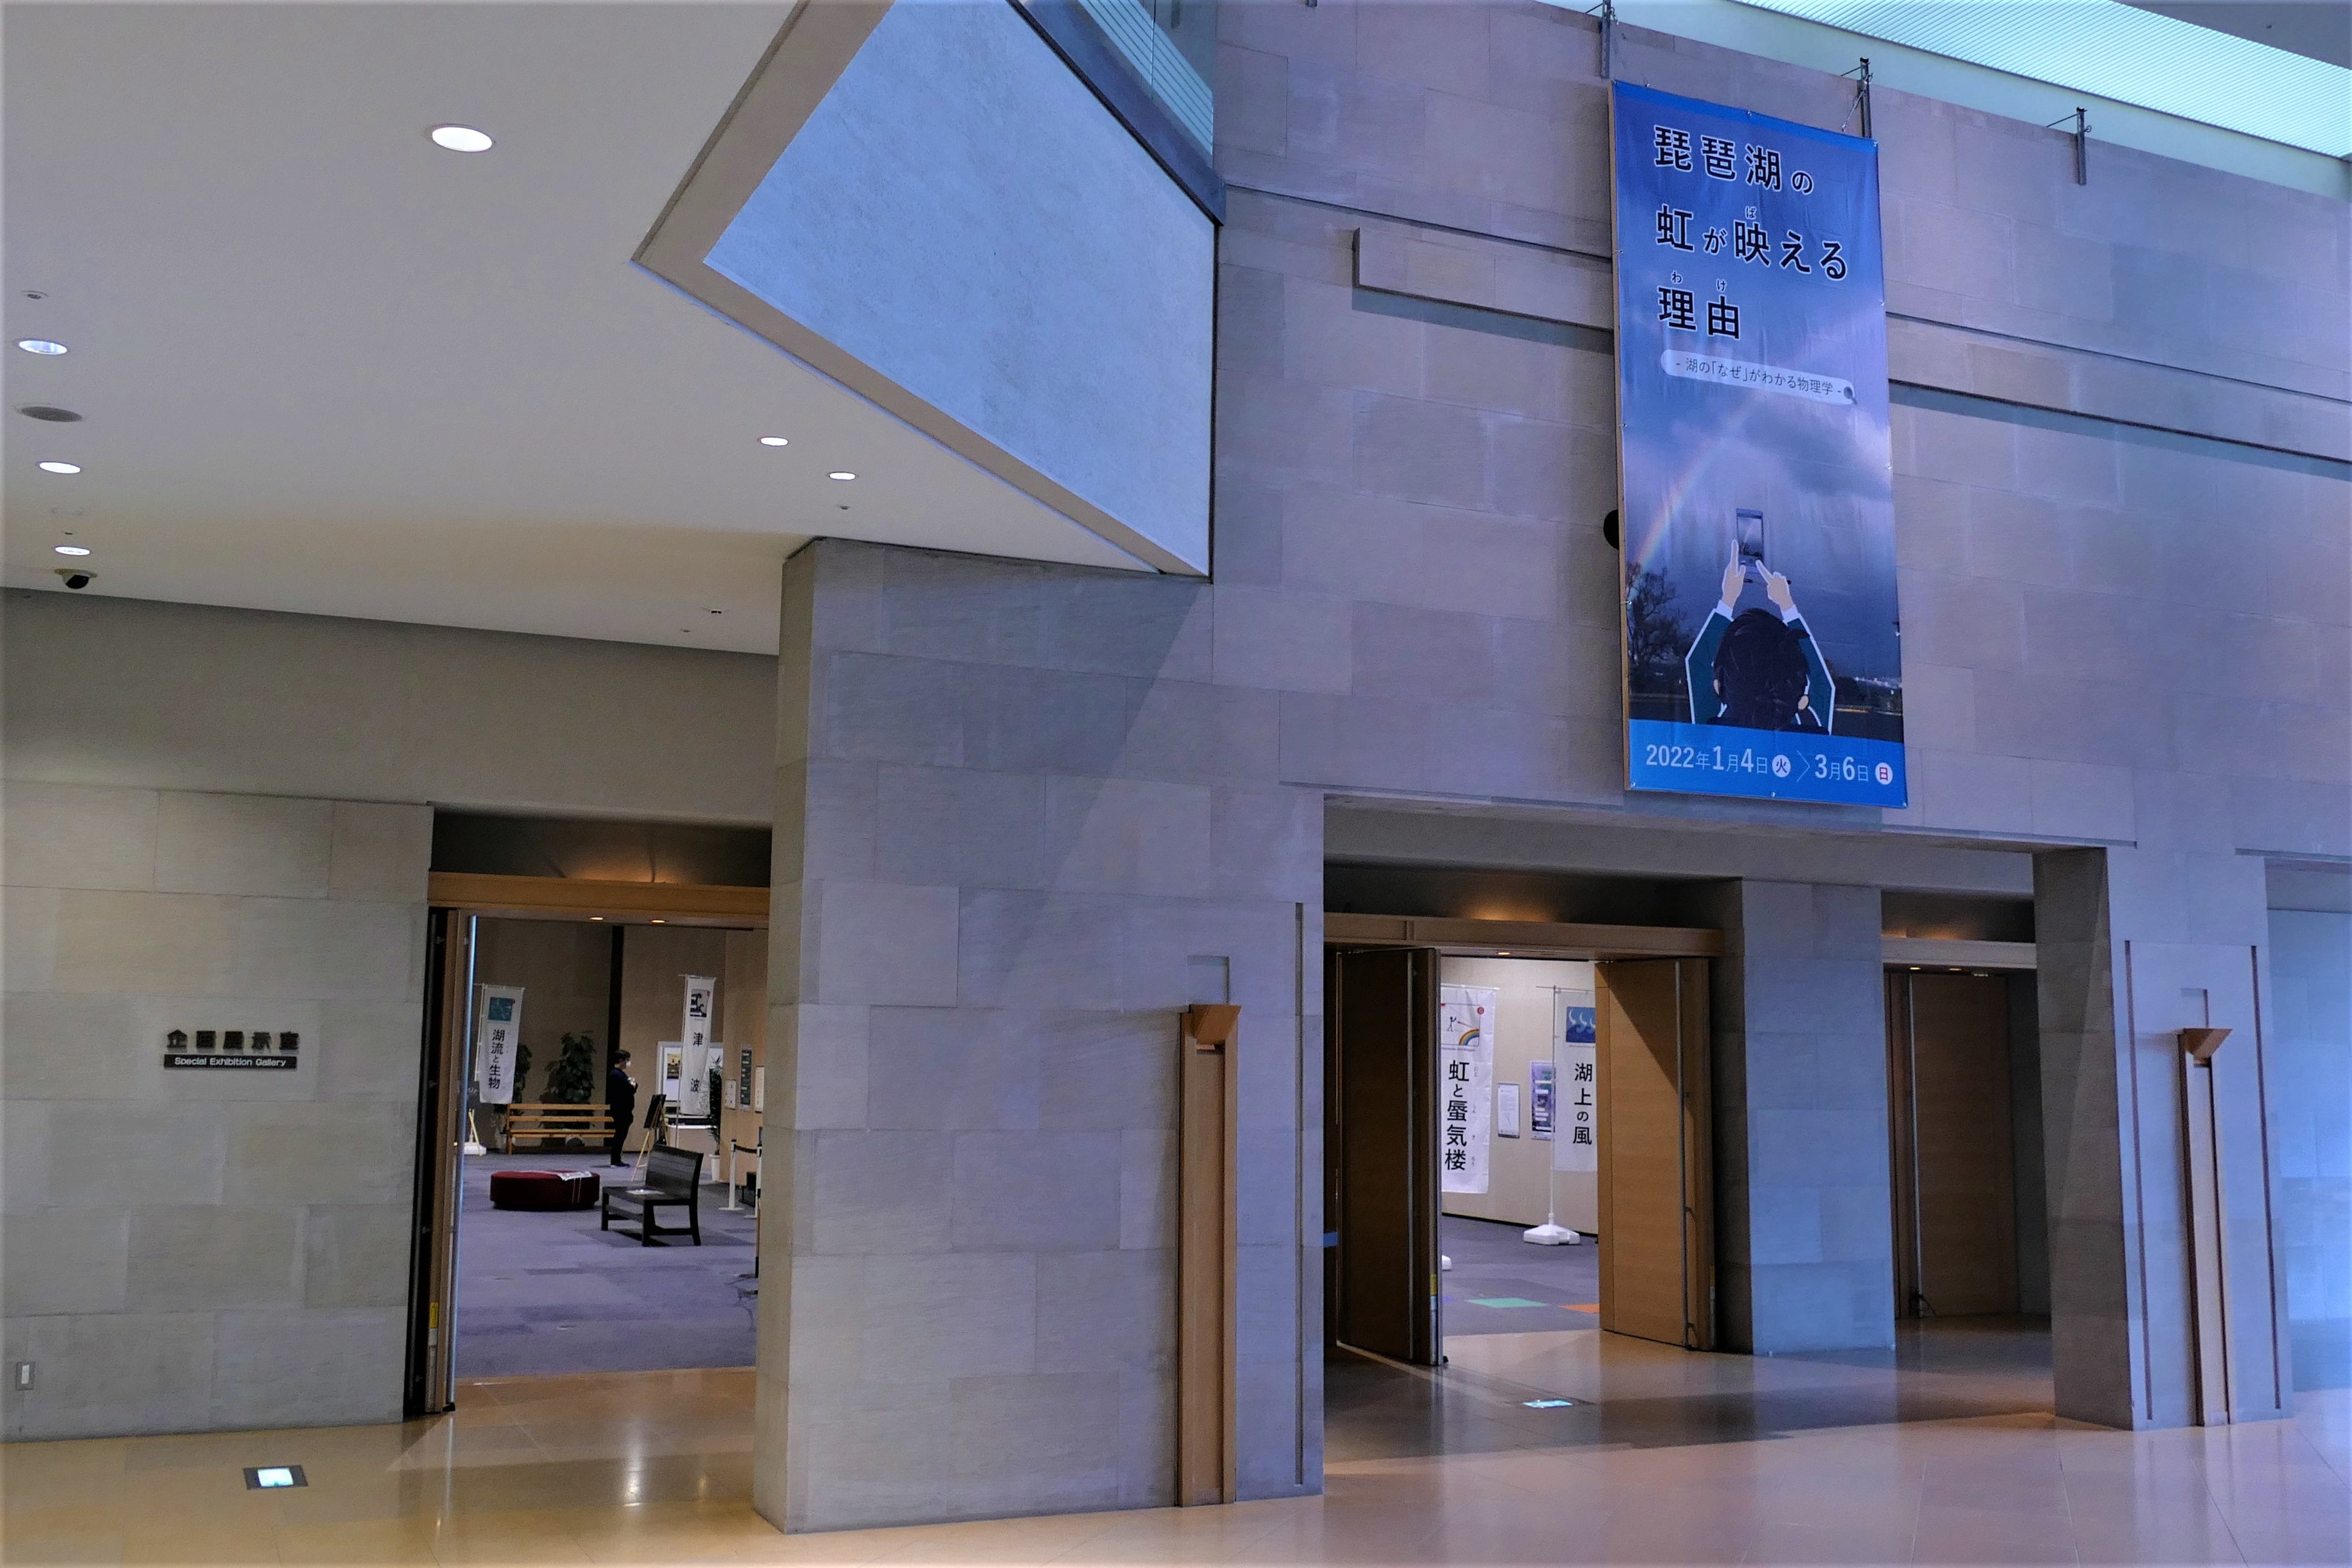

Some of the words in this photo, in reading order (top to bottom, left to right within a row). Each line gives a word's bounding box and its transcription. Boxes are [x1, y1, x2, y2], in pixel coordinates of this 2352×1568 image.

[1654, 125, 1814, 194] 琵琶湖の
[1656, 204, 1848, 281] 虹が映える
[1746, 206, 1756, 219] ば
[1657, 285, 1741, 340] 理由
[174, 1057, 206, 1066] Special
[209, 1057, 252, 1066] Exhibition
[255, 1058, 286, 1067] Gallery
[488, 1029, 505, 1090] 湖流と生物
[1444, 1060, 1470, 1171] 虹と蜃気楼
[1572, 1063, 1593, 1145] 湖上の風
